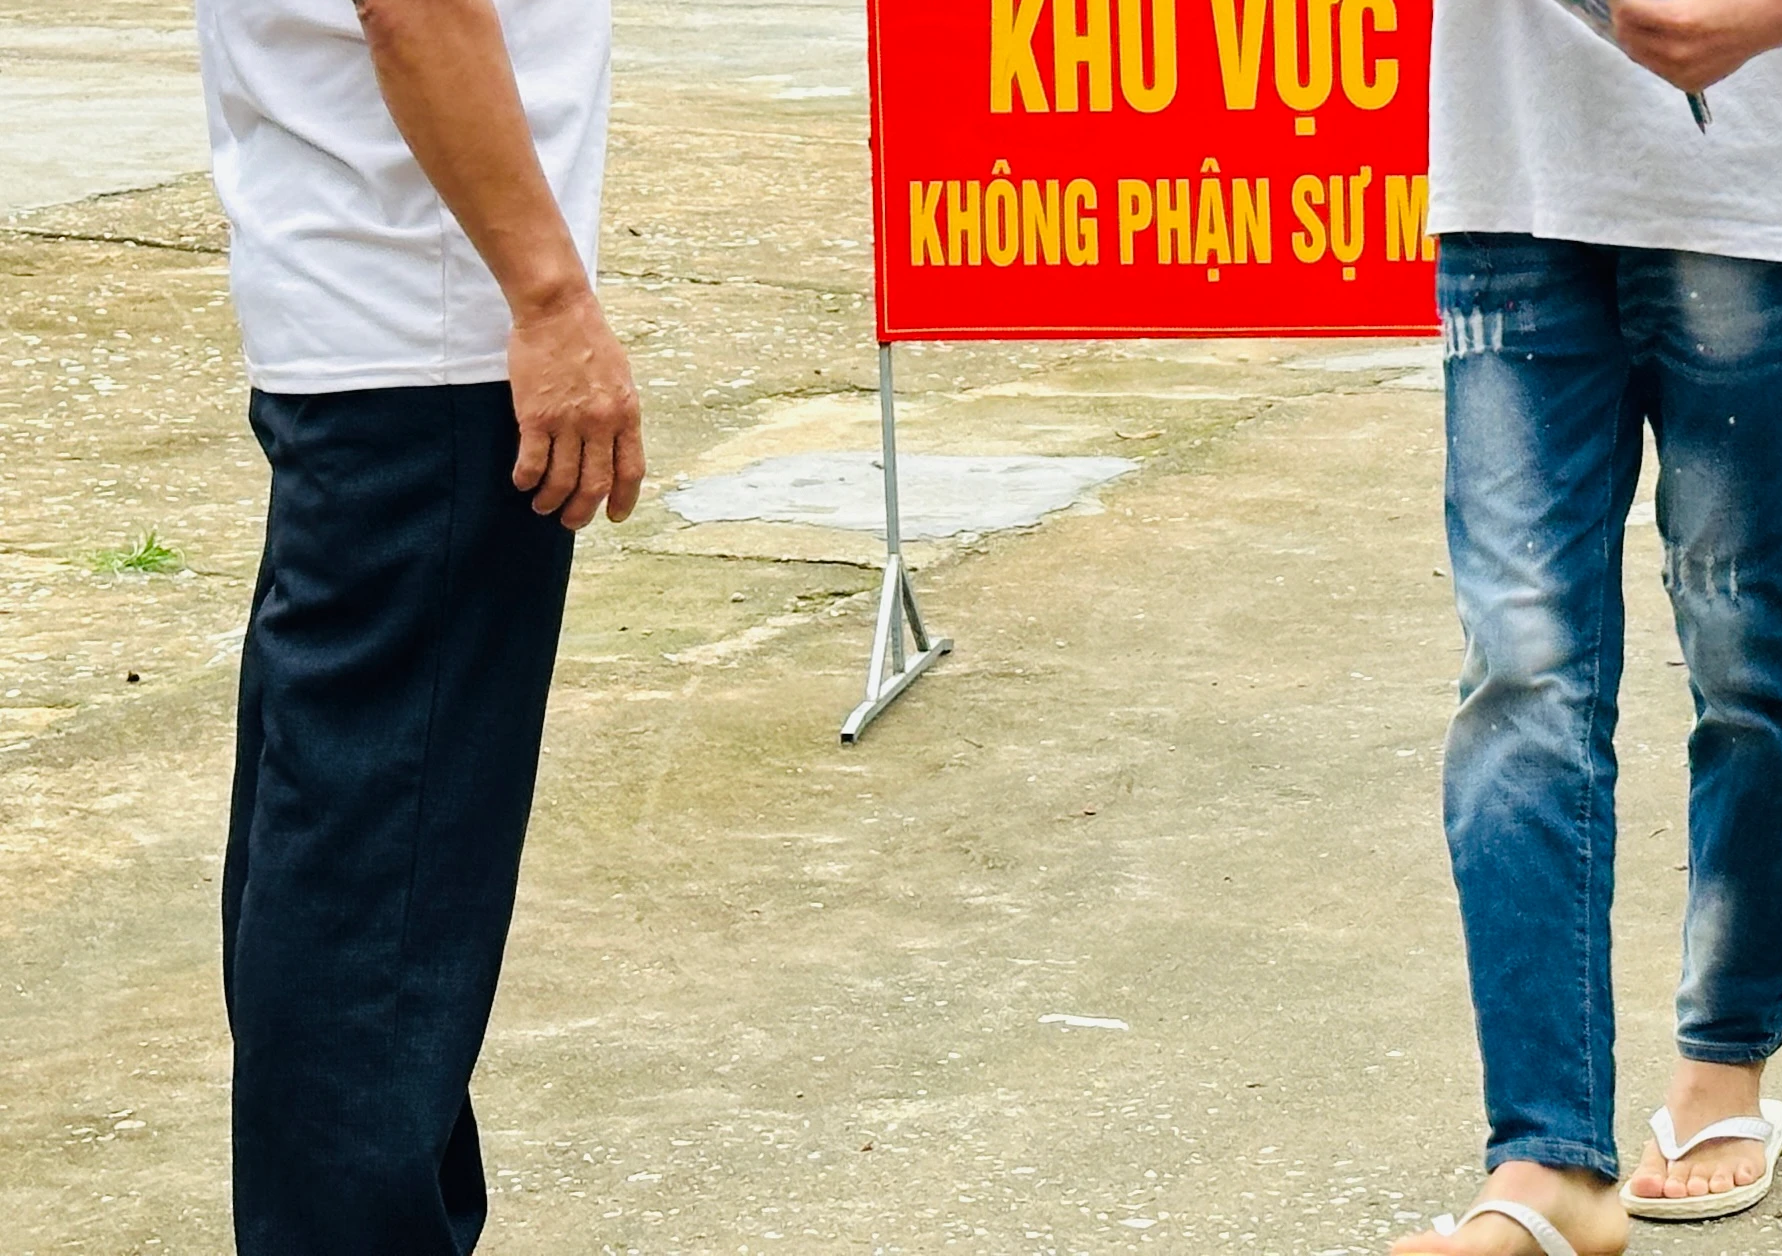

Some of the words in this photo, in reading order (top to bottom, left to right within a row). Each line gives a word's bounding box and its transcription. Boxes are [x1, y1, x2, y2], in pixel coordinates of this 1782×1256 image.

[909, 158, 1099, 267] KHÔNG
[1117, 157, 1272, 282] PHẬN
[1291, 165, 1373, 281] SỰ
[1384, 174, 1436, 262] M
